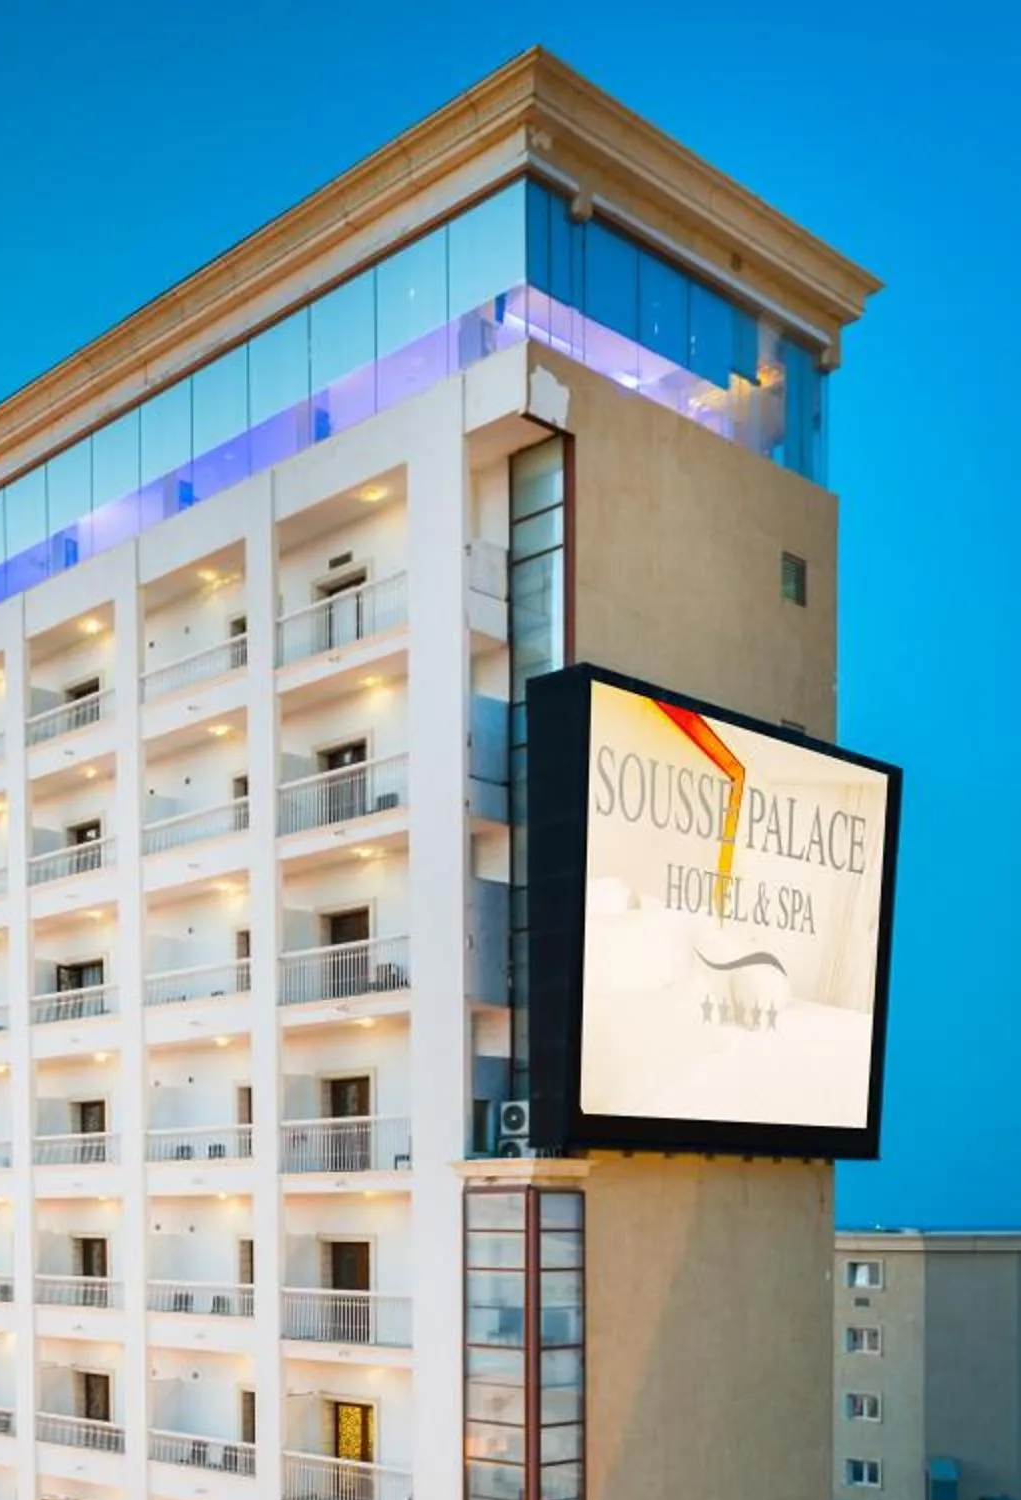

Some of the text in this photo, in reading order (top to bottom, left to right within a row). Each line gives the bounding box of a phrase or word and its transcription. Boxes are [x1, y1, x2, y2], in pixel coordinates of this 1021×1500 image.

[595, 745, 867, 875] SOUSSE PALACE
[666, 863, 816, 935] HOTEL & SPA
